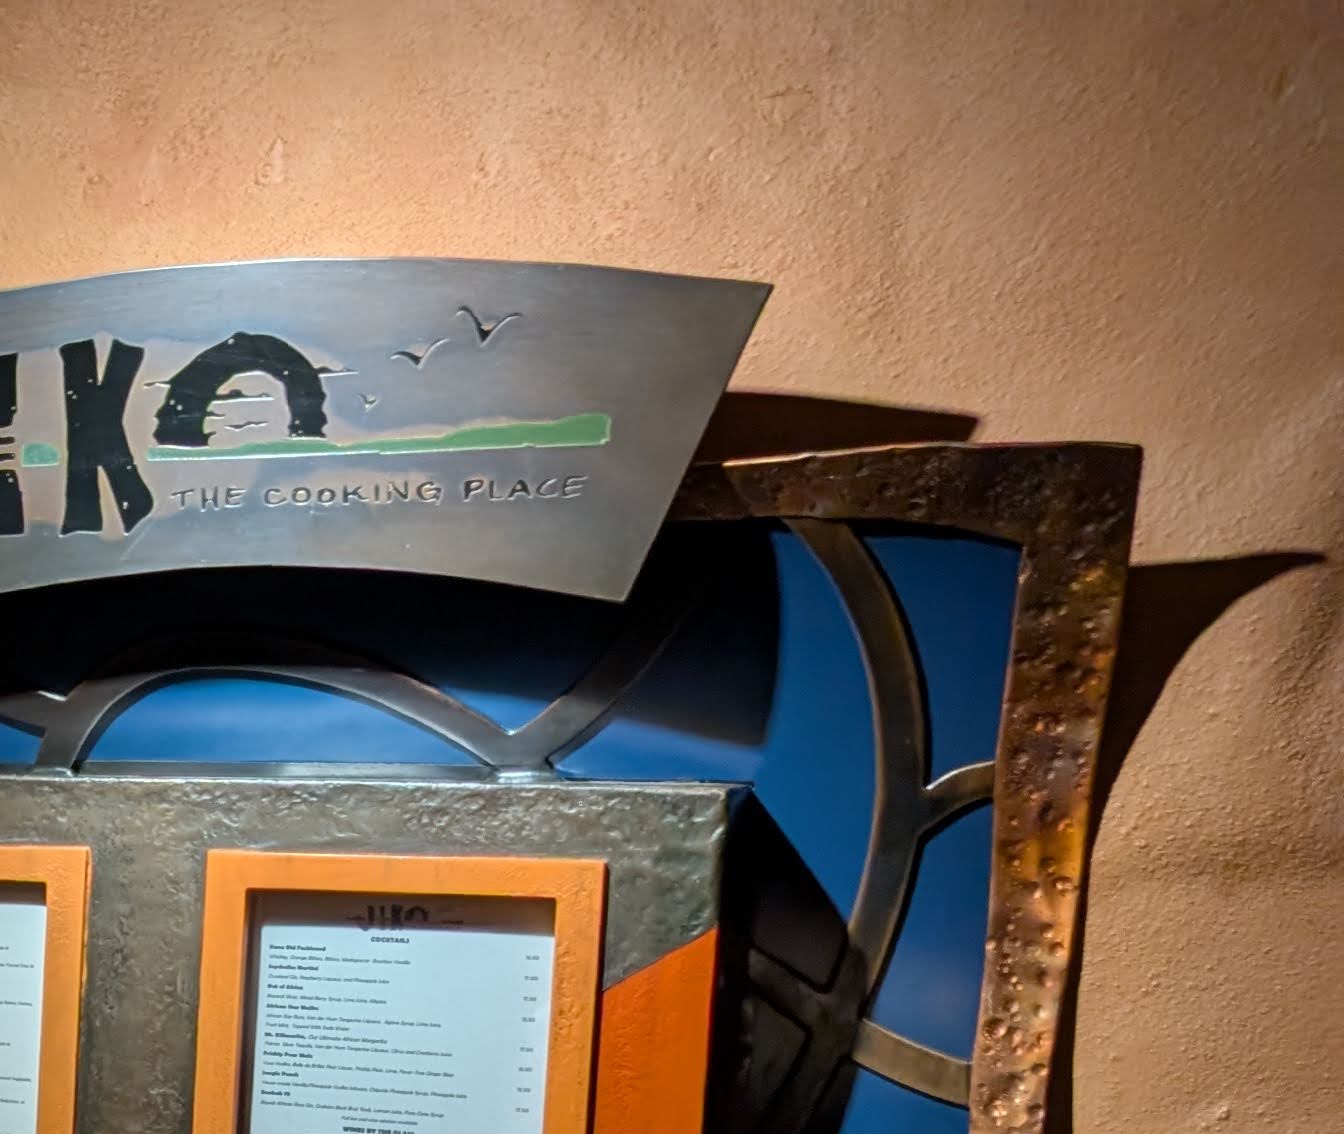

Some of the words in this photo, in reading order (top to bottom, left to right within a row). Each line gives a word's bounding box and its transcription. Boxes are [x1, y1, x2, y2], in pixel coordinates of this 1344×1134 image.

[170, 487, 246, 512] THE
[263, 480, 443, 508] COOKING
[463, 475, 589, 501] PLACE
